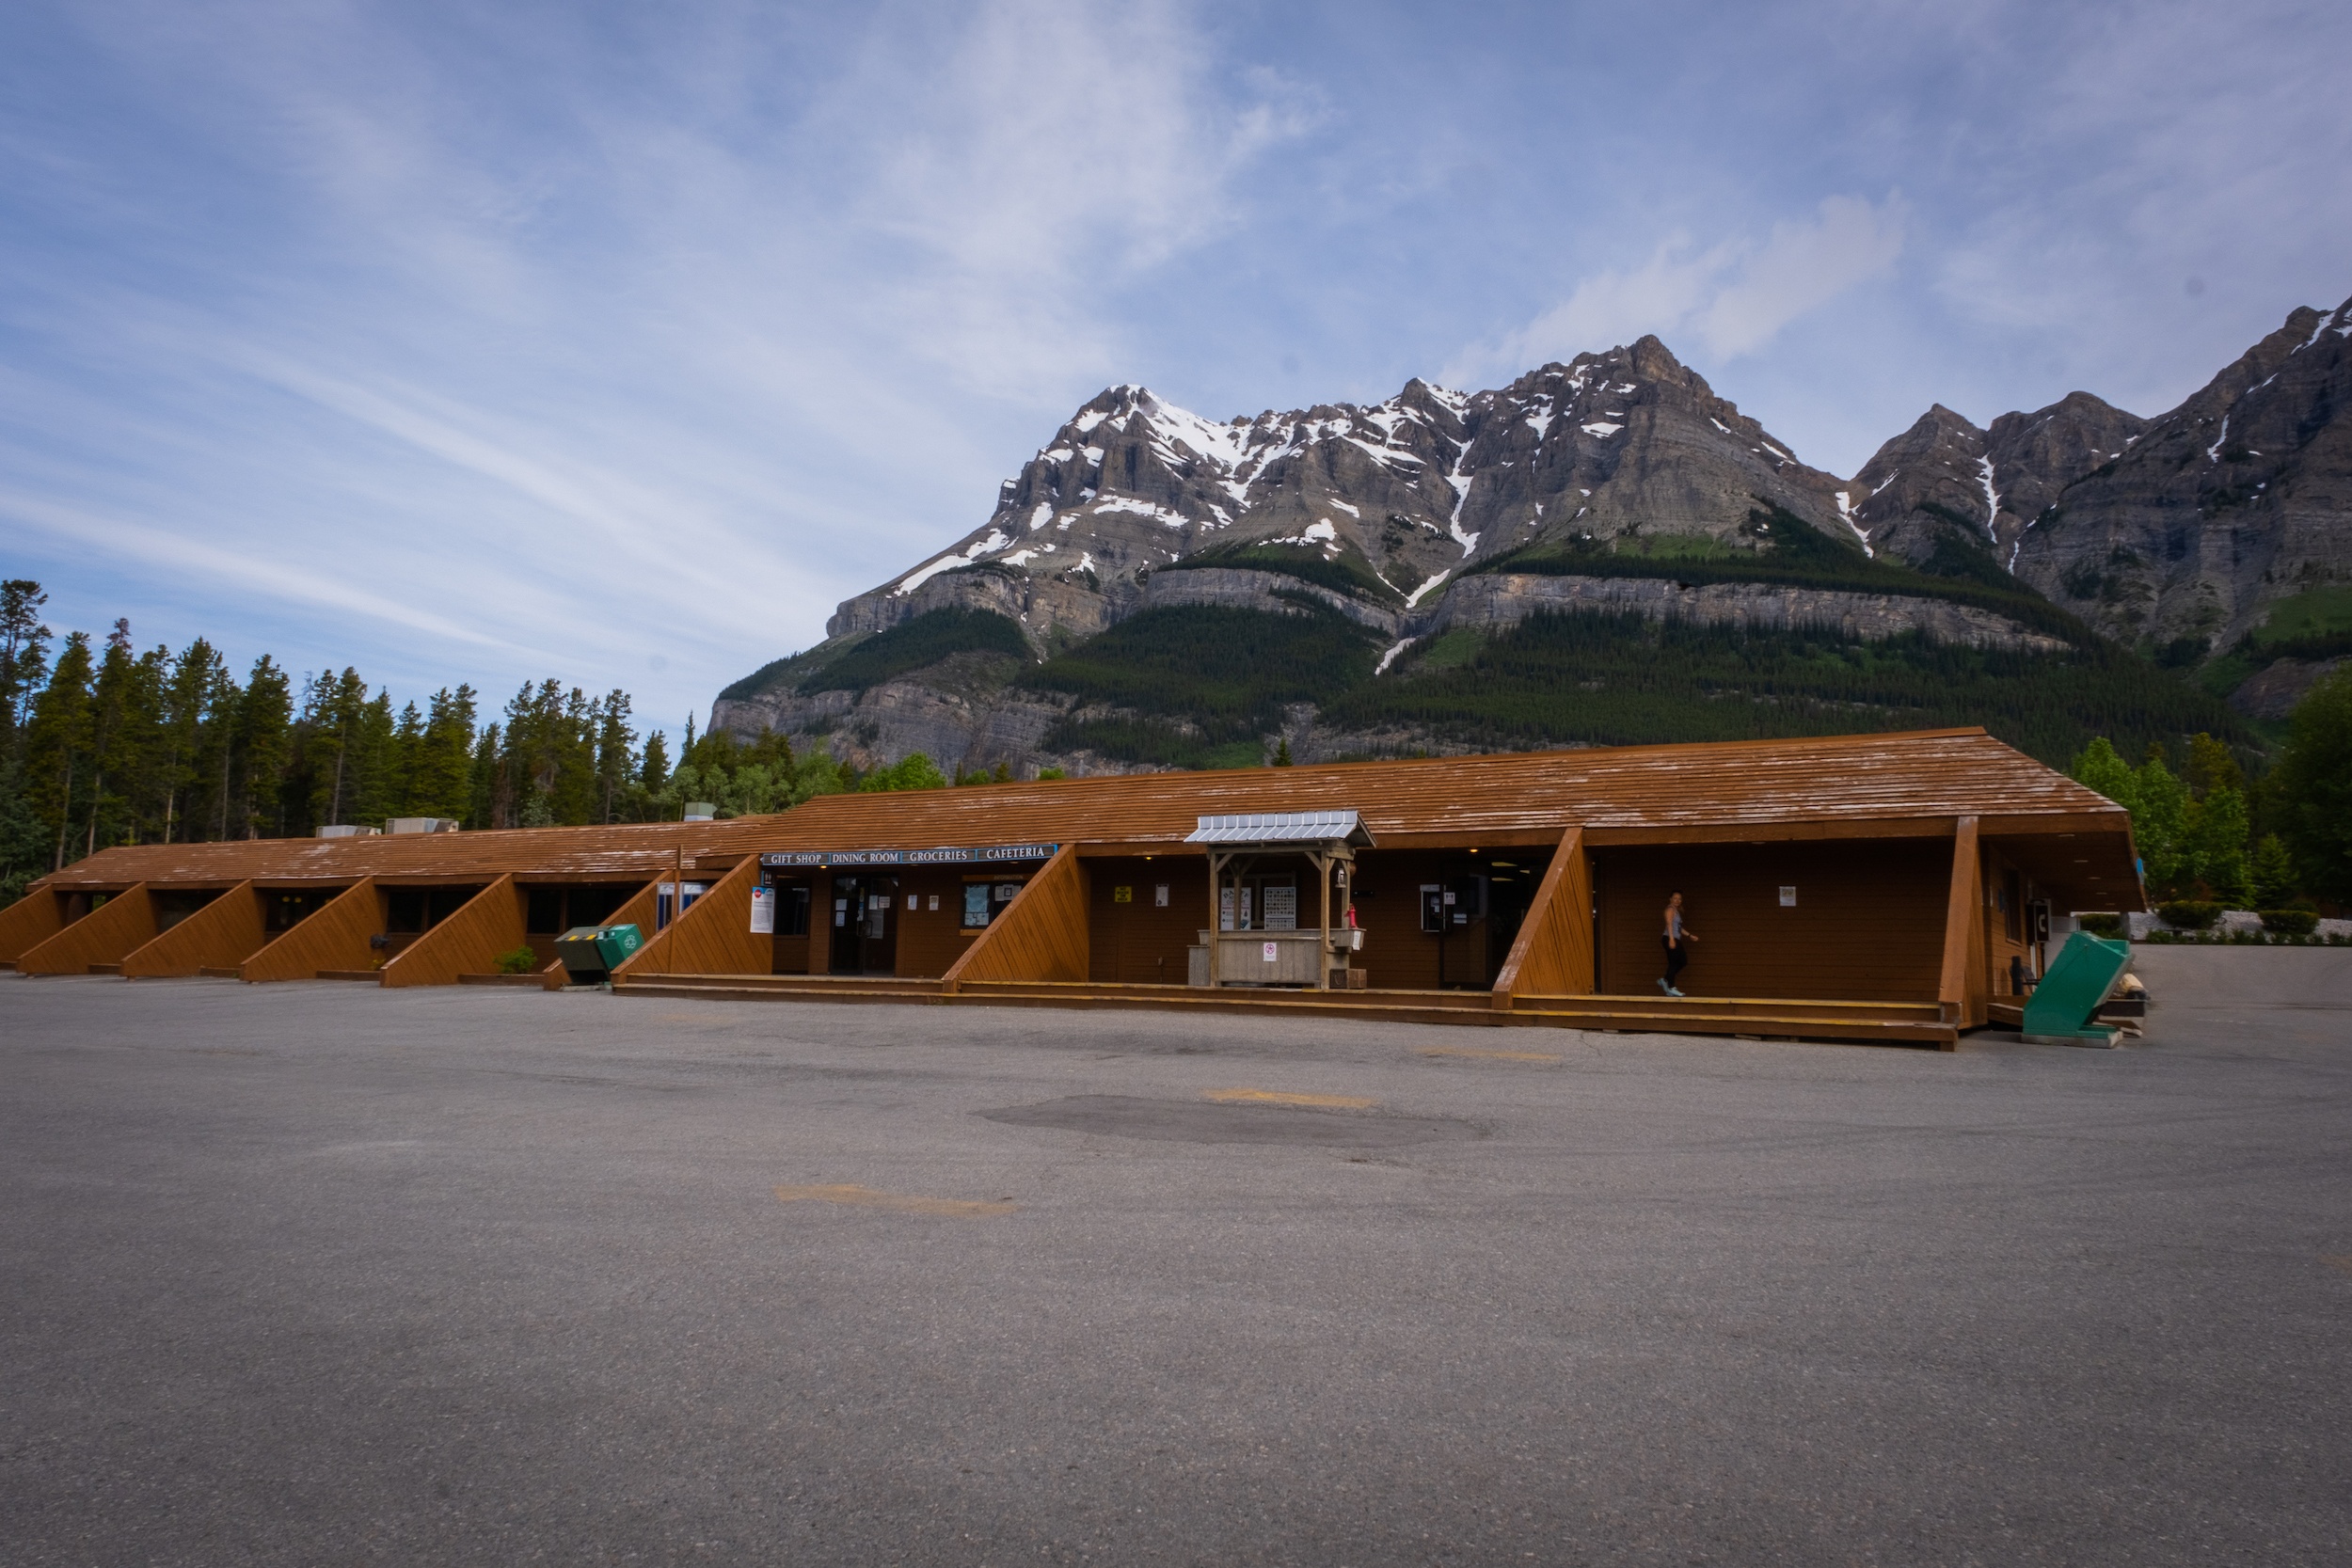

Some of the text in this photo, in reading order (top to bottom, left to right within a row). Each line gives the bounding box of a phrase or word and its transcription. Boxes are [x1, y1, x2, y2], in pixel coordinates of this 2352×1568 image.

[796, 853, 822, 863] SHOP
[833, 852, 898, 863] DINING ROOM
[909, 850, 967, 861] GROCERIES
[987, 847, 1044, 860] CAFETERIA
